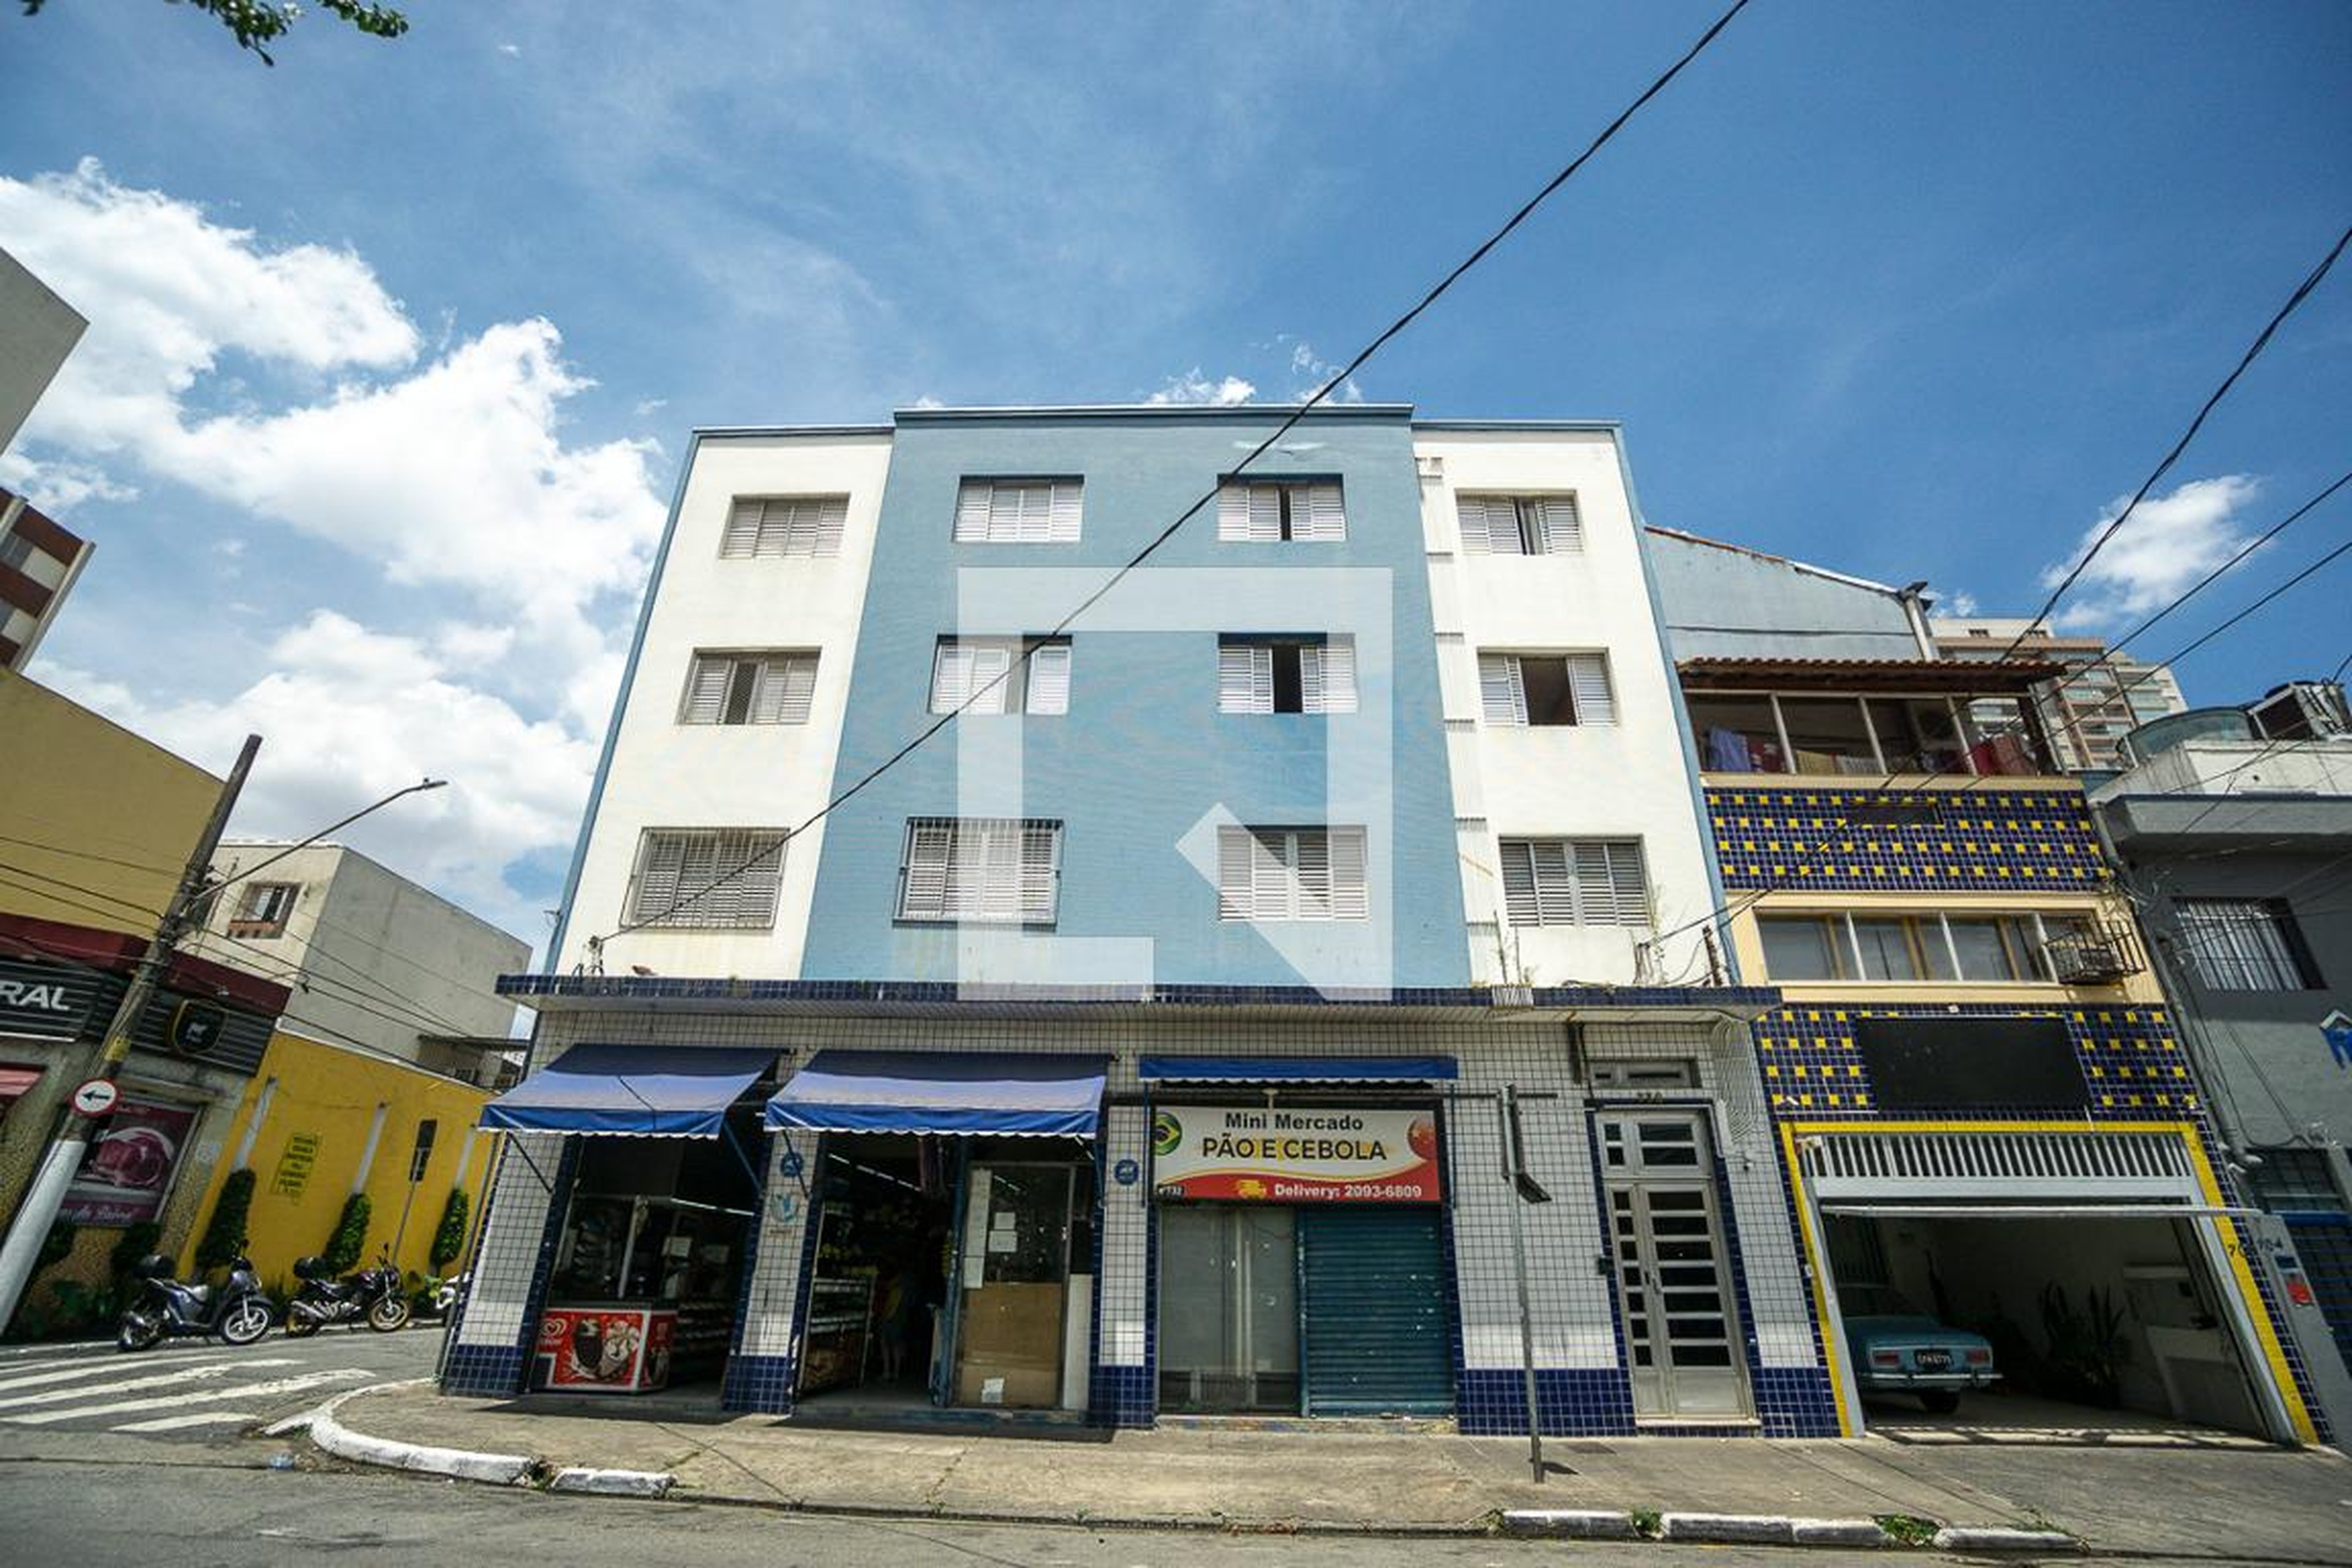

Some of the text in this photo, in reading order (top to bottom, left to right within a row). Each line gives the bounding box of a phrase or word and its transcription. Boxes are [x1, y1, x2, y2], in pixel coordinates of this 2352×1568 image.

[1226, 1112, 1364, 1131] Mini Mercado
[1203, 1133, 1387, 1160] PÃO E CEBOLA
[1275, 1183, 1340, 1199] Delivery:
